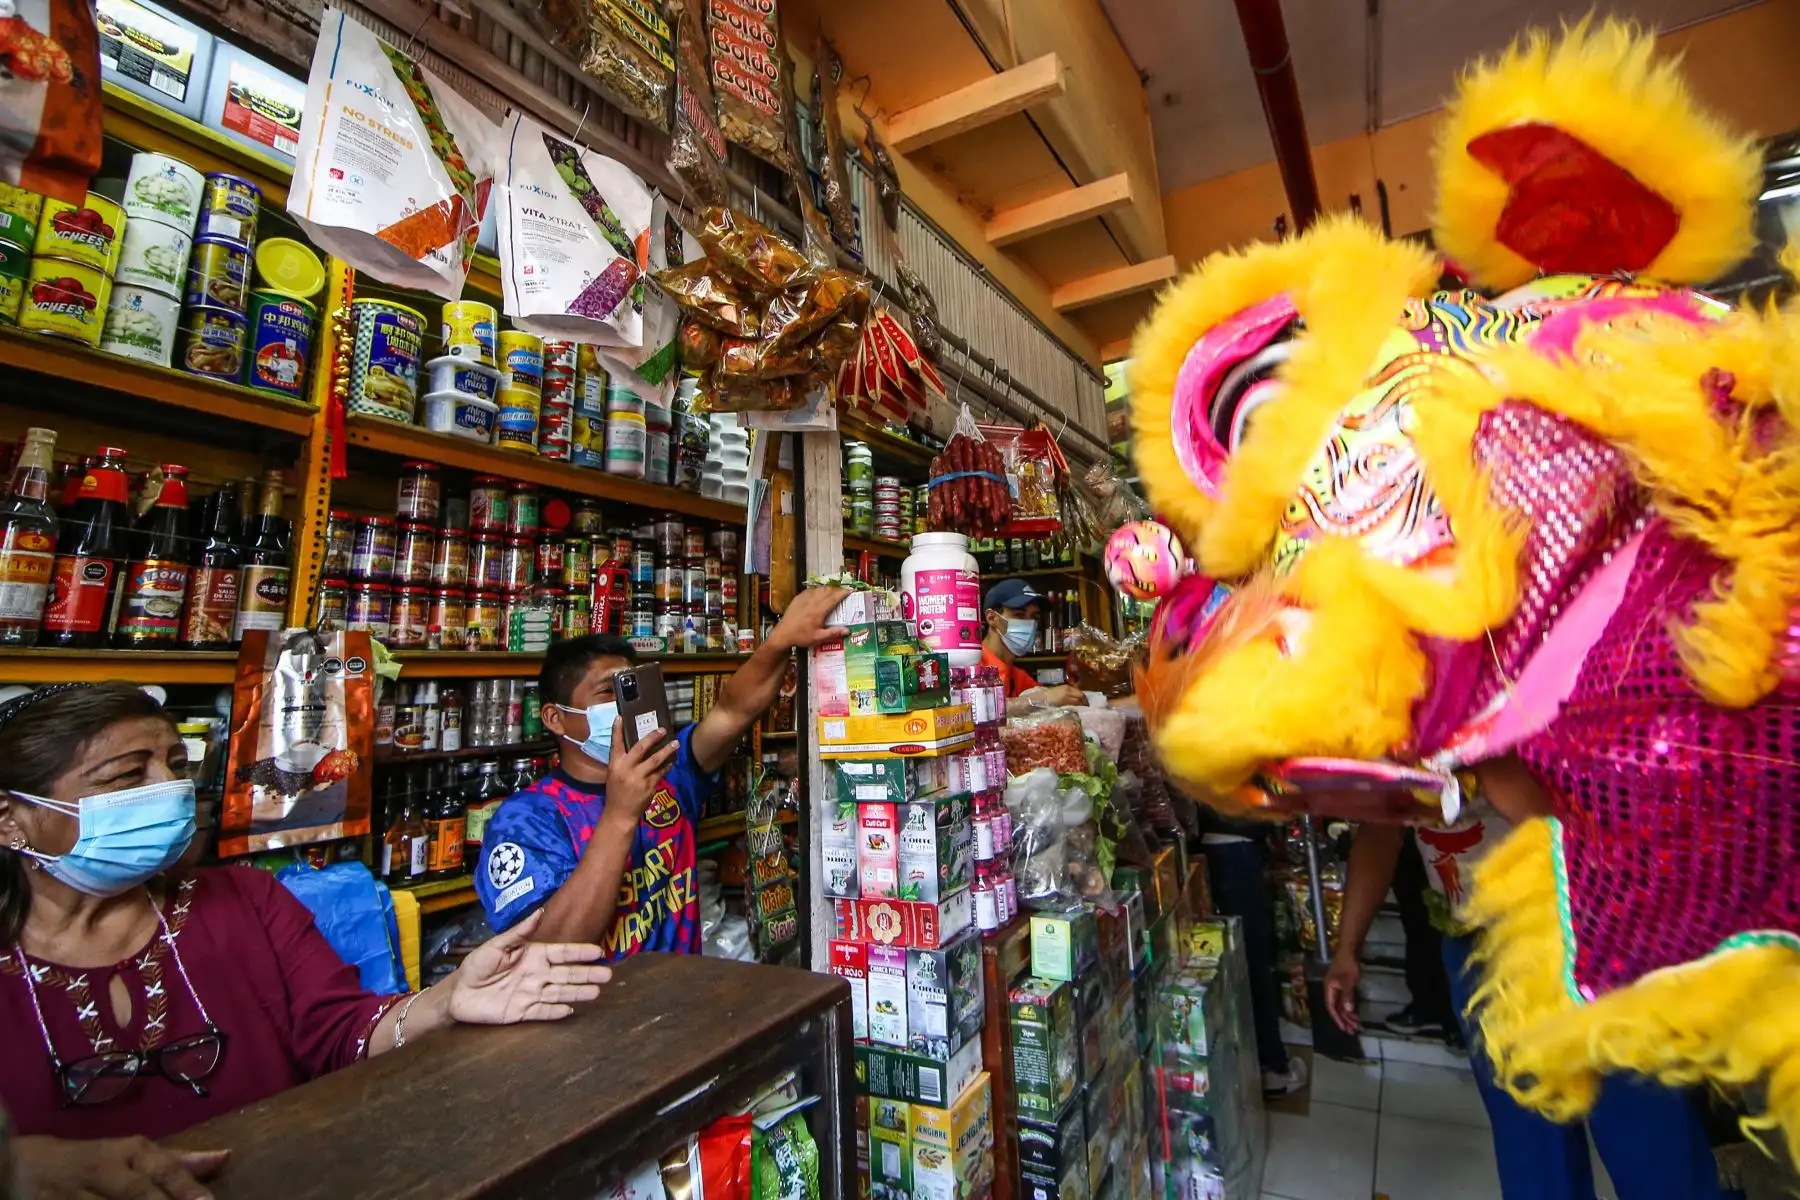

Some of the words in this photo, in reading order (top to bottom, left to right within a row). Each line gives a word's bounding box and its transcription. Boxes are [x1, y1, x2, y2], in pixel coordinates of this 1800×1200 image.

[710, 0, 777, 50] Boldo
[712, 28, 779, 82] Boldo
[714, 60, 782, 115] Boldo
[342, 105, 366, 121] NO
[367, 117, 414, 150] STRESS
[521, 207, 547, 221] VITA
[466, 370, 488, 382] shiro
[466, 405, 487, 418] shiro
[918, 593, 954, 606] WOMEN'S
[919, 604, 947, 616] PROTEIN
[617, 839, 675, 907] SPORT
[768, 915, 798, 943] Stevia
[843, 966, 864, 978] ROJO
[869, 964, 888, 976] CHANCA
[914, 1124, 948, 1141] JENGIBRE
[956, 1109, 990, 1153] JENGIBRE
